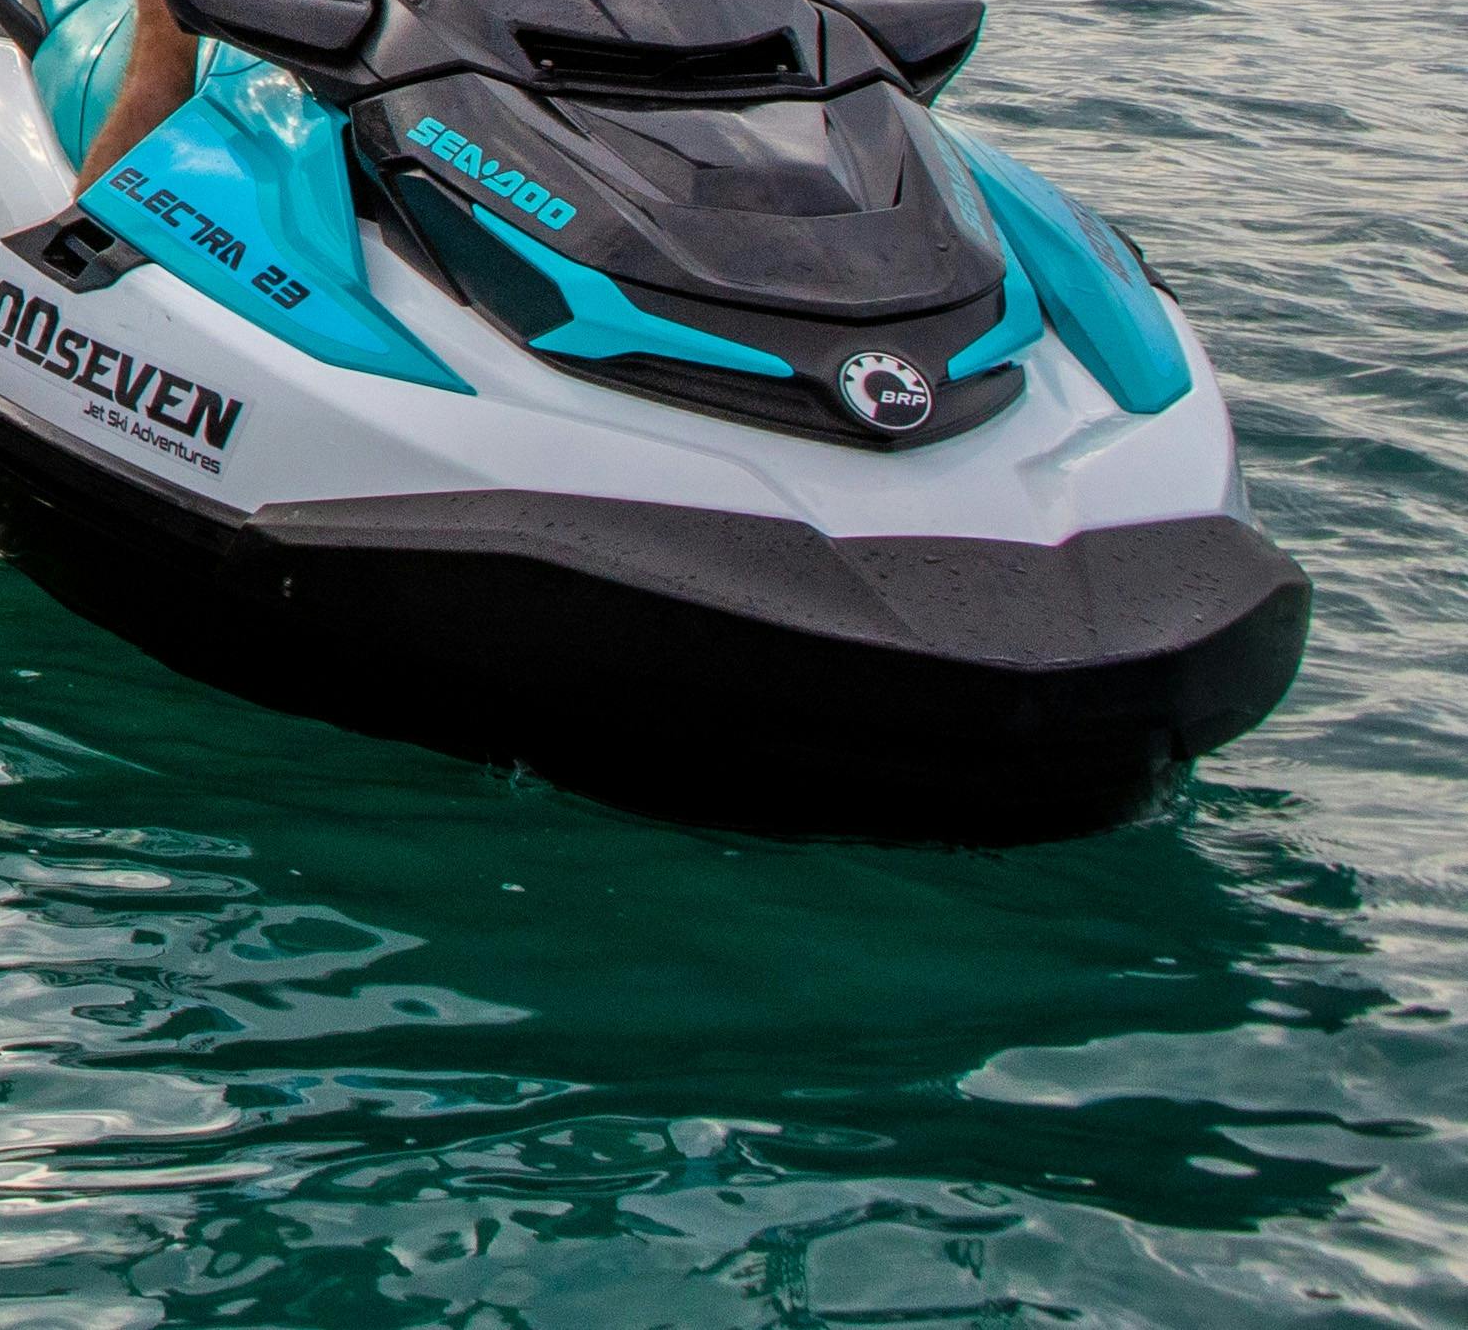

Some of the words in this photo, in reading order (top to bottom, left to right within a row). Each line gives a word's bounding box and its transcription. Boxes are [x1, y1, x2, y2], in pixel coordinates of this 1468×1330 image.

[109, 167, 247, 271] ELECTRA
[251, 264, 311, 310] 23
[879, 389, 927, 407] BRP
[83, 400, 105, 422] Jet
[107, 409, 128, 432] Ski
[130, 422, 222, 475] Adventures
